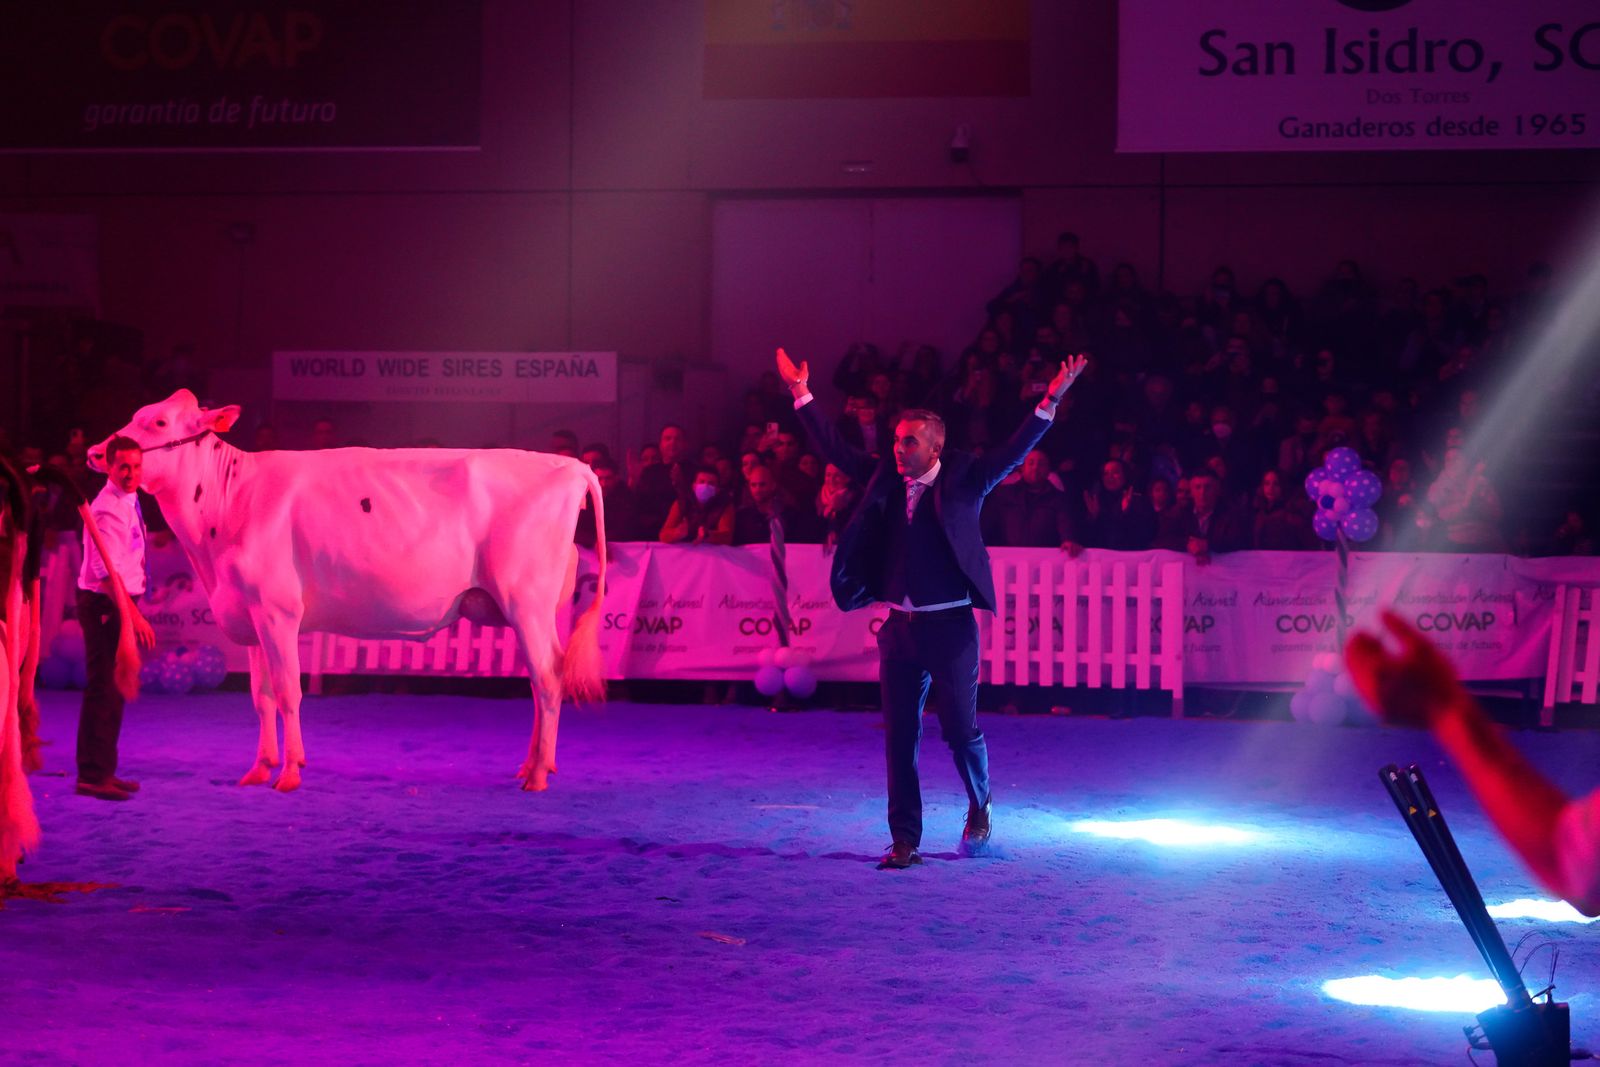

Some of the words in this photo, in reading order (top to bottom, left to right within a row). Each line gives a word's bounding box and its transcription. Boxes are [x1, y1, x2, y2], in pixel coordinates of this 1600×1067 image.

[101, 10, 323, 70] COVAP
[1198, 28, 1296, 76] San
[1324, 27, 1502, 83] Isidro,
[1366, 88, 1401, 104] Dos
[1407, 87, 1472, 105] Torres
[207, 95, 241, 124] de
[246, 95, 337, 128] futuro
[1278, 116, 1415, 139] Ganaderos
[1425, 115, 1499, 137] desde
[1515, 113, 1587, 136] 1965
[290, 357, 366, 378] WORLD
[376, 357, 429, 378] WIDE
[442, 357, 502, 378] SIRES
[515, 354, 599, 378] ESPAÑA
[1416, 610, 1496, 632] COVAP
